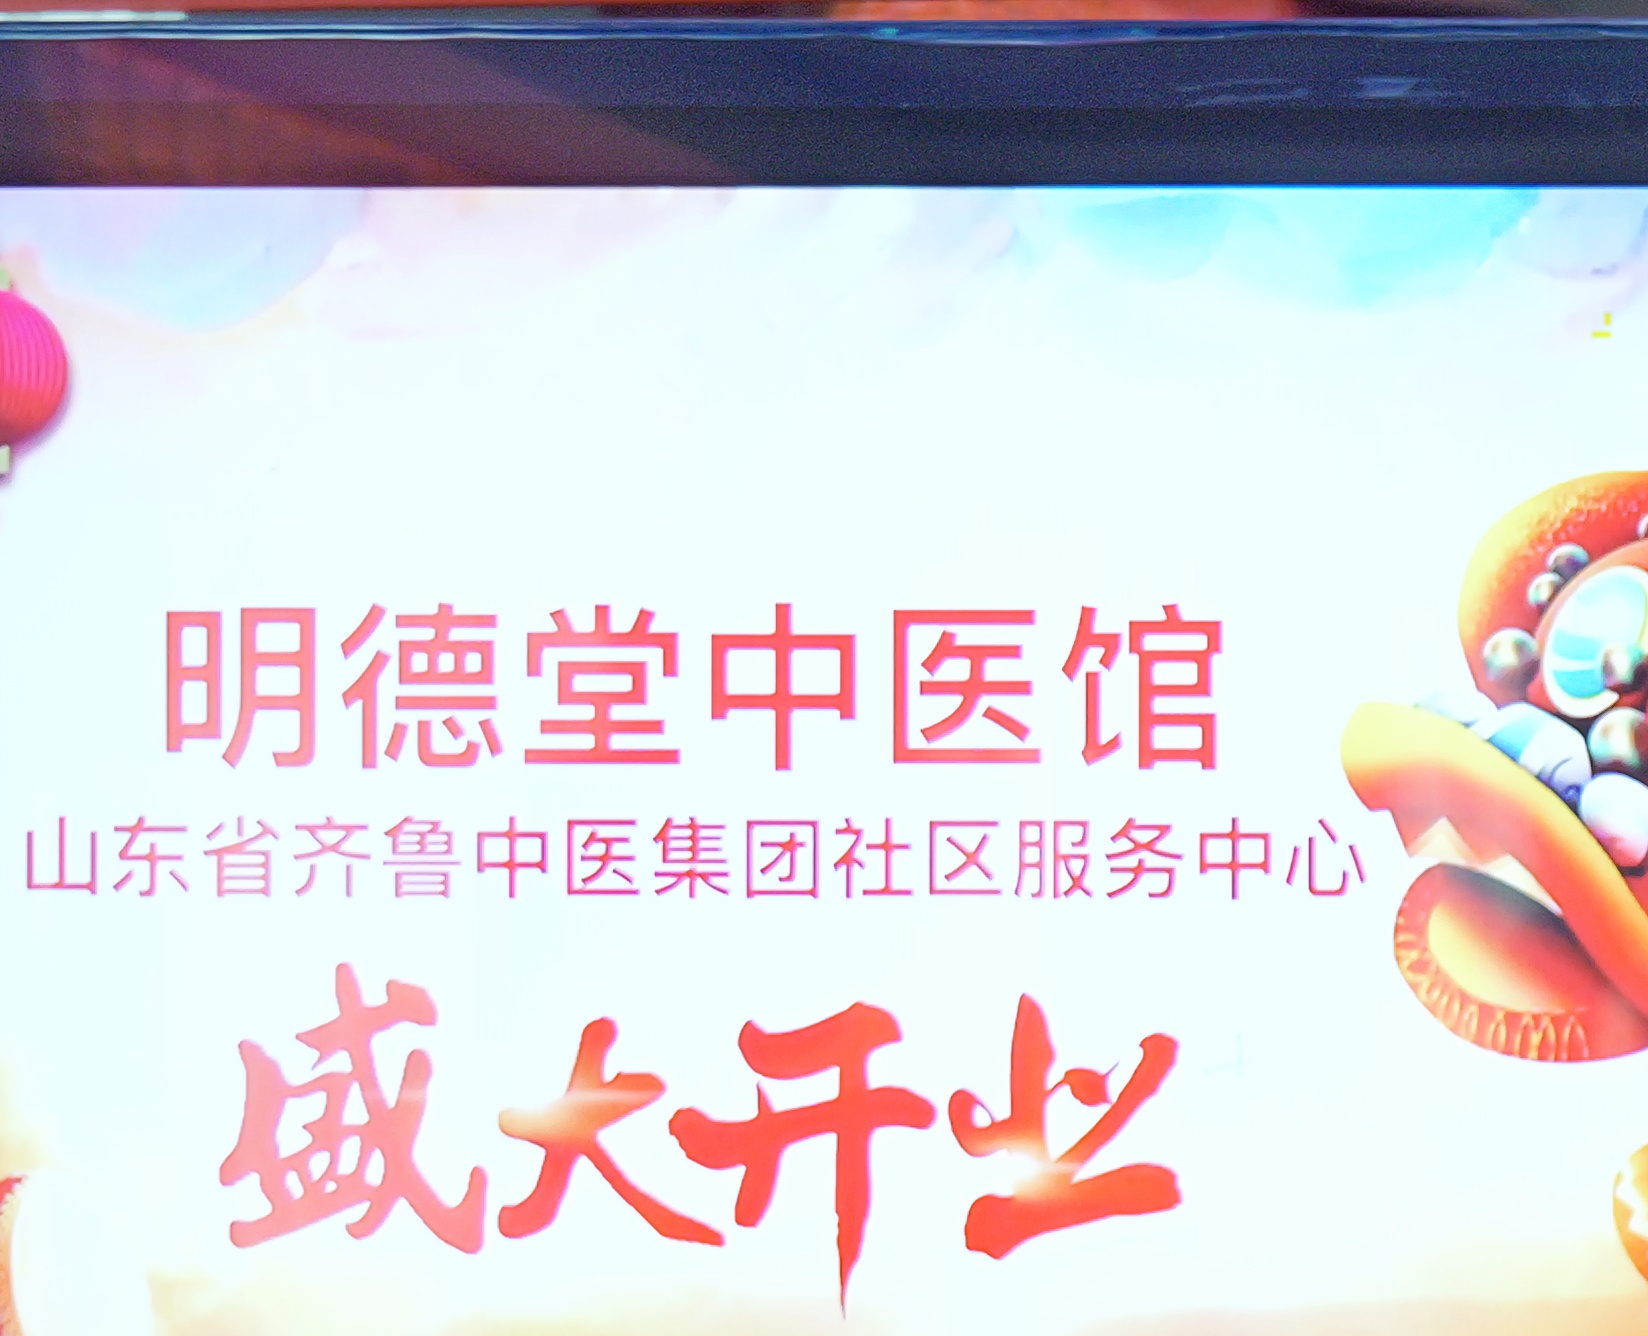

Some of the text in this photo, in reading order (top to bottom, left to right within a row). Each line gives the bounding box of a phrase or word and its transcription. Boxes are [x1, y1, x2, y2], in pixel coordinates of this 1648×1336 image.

[165, 601, 1223, 772] 明德堂中医馆
[26, 815, 1368, 900] 山东省齐鲁中医集团社区服务中心
[219, 961, 1183, 1320] 盛大开业
